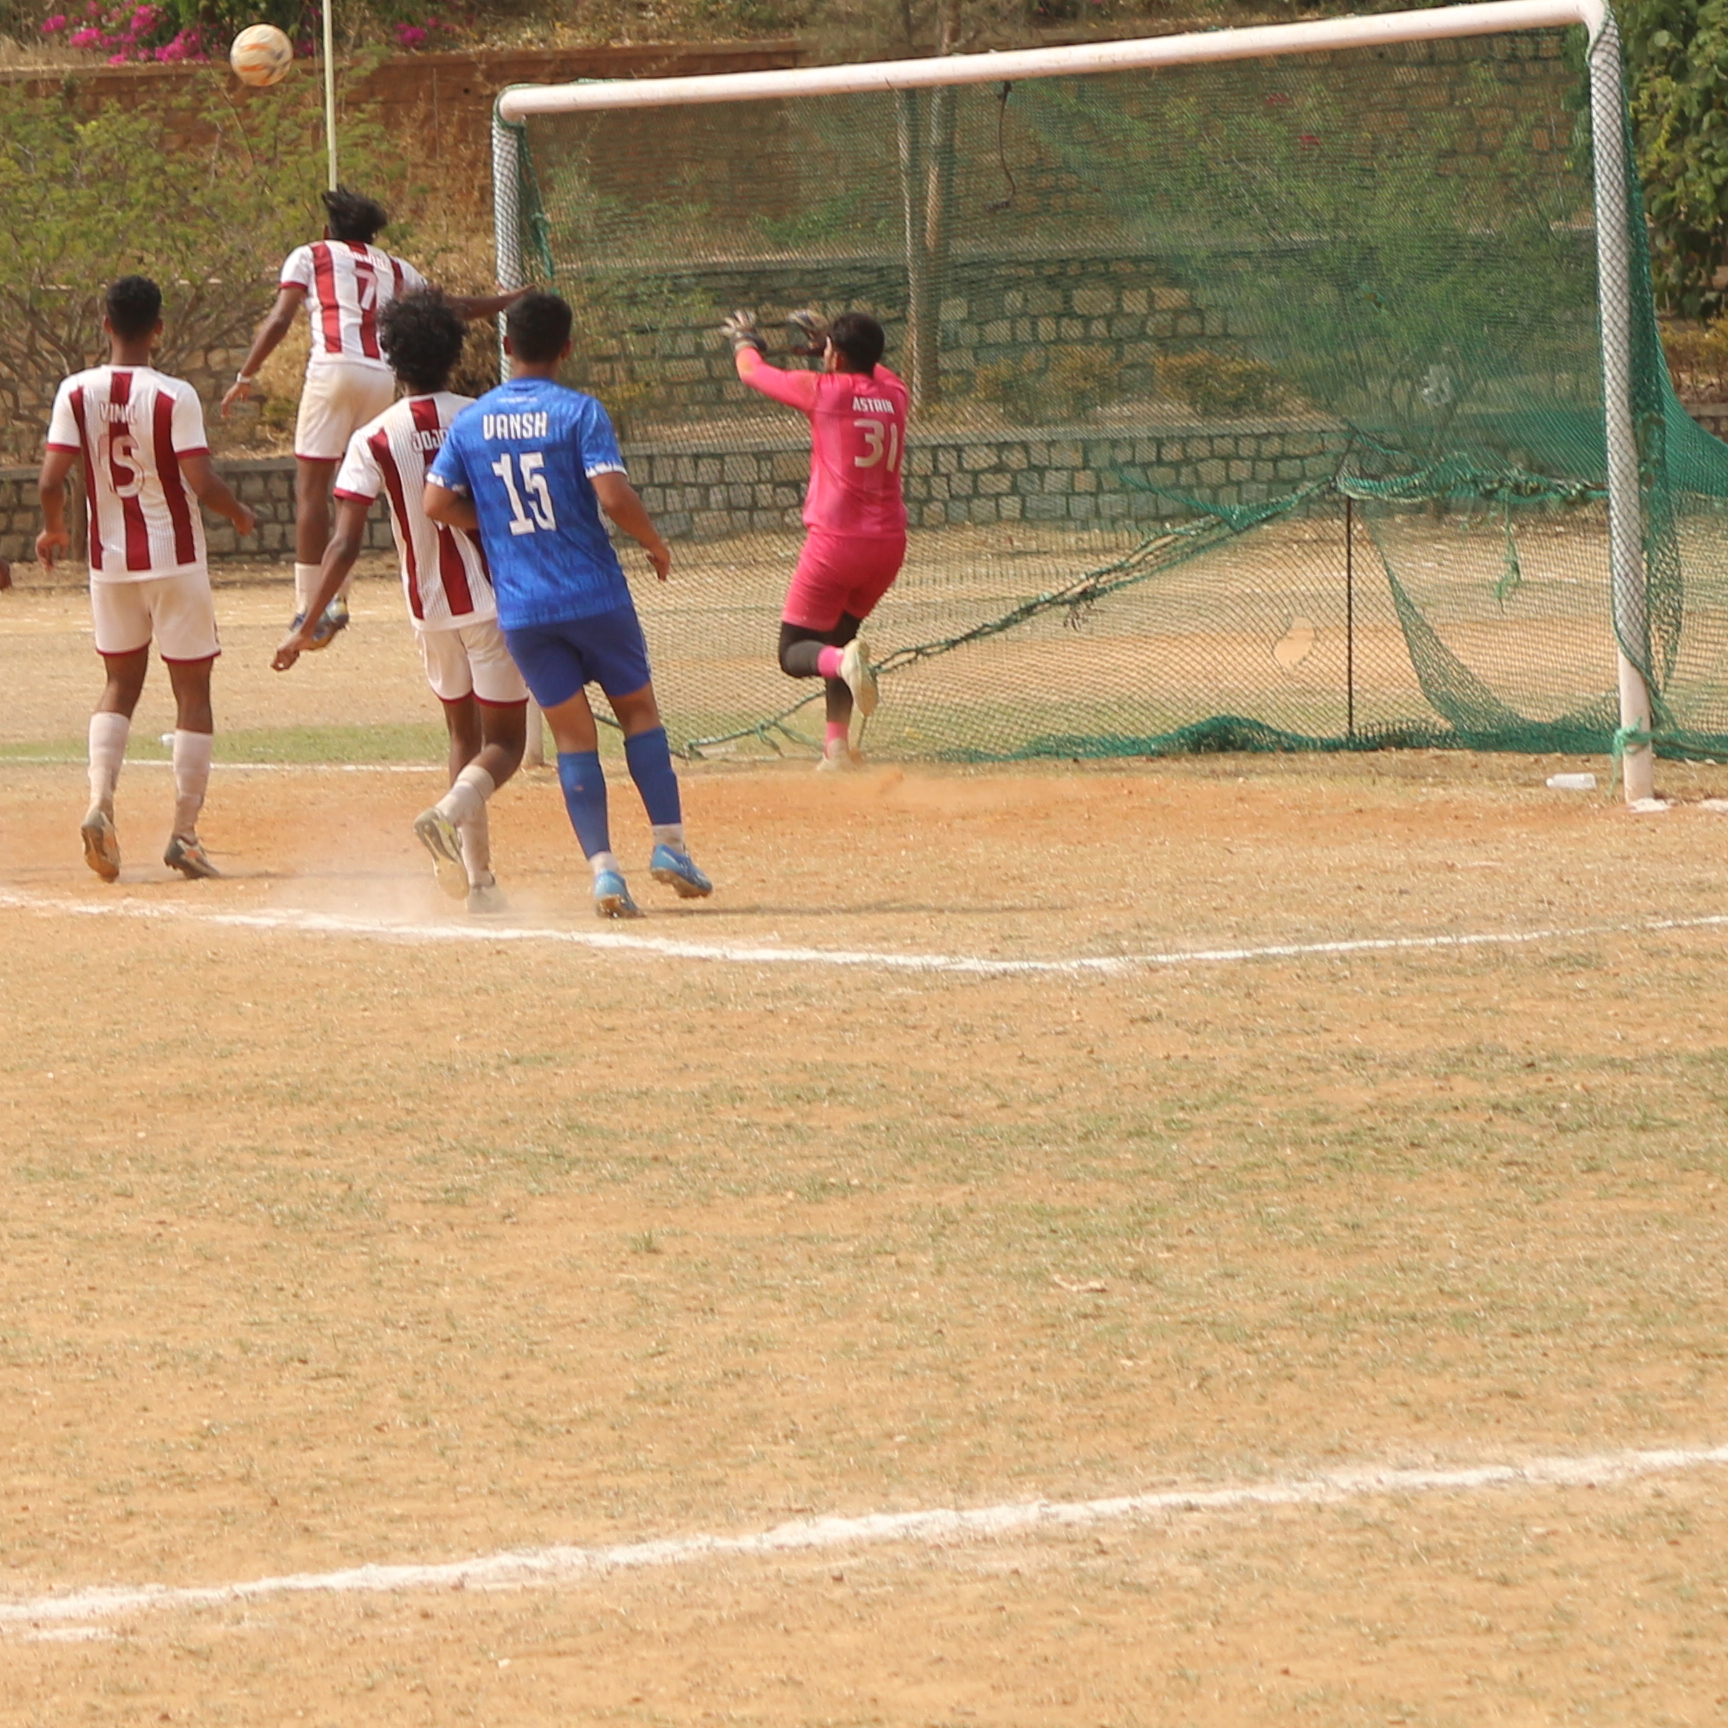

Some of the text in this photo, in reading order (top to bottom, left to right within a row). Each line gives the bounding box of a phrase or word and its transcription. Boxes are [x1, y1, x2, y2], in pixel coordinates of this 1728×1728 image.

[352, 268, 379, 311] 7
[482, 410, 549, 441] VANSH
[853, 418, 899, 472] 31
[491, 452, 557, 537] 15
